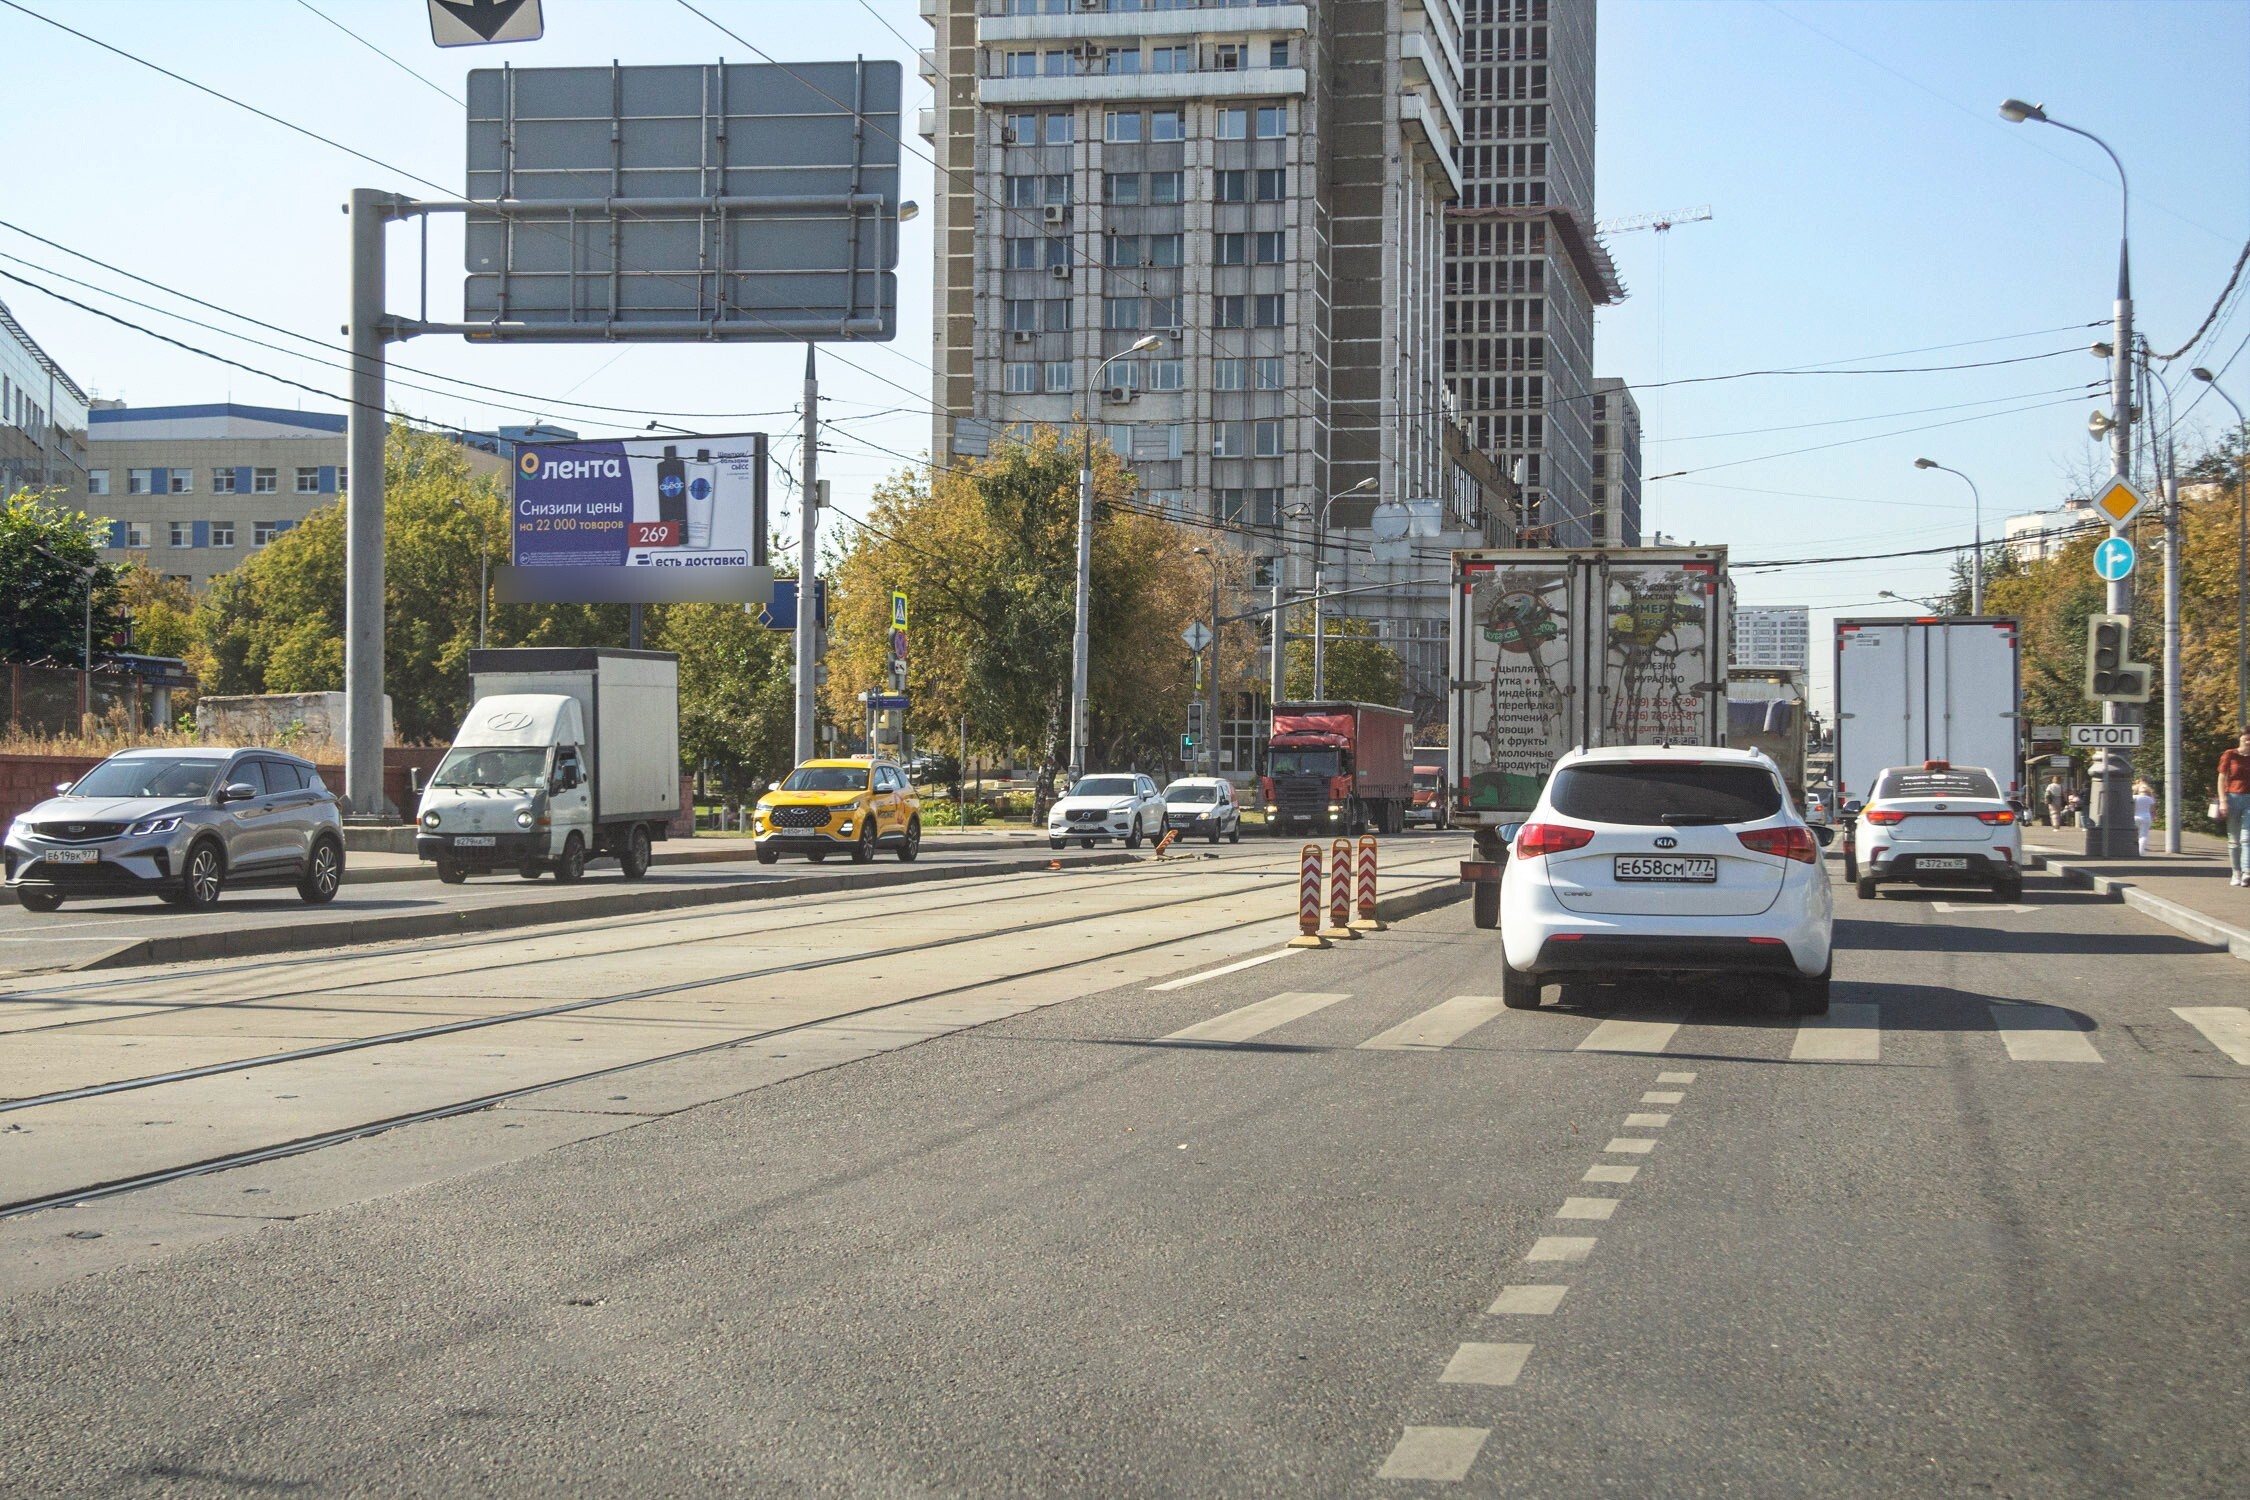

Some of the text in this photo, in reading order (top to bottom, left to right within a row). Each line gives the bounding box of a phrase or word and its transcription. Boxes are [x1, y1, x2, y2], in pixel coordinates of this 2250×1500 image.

[542, 459, 622, 480] лента
[519, 499, 623, 517] Снизили цены
[519, 518, 624, 532] на 22 000 товаров
[639, 526, 669, 543] 269
[656, 556, 745, 566] есть доставка
[1641, 618, 1700, 626] ПРОКТОВ
[1499, 665, 1544, 674] цыплята
[1498, 678, 1556, 687] утка гусь
[1627, 675, 1685, 684] ТУРАЛЬНО
[1498, 688, 1544, 698] индейка
[1498, 702, 1555, 711] перепелка
[1498, 714, 1549, 722] копчения
[1498, 726, 1534, 735] овощи
[2078, 728, 2133, 743] СТОП
[1507, 737, 1548, 748] фрукты
[1498, 750, 1554, 758] молочные
[1497, 761, 1549, 770] продукты
[1656, 838, 1675, 847] KIA
[47, 850, 81, 861] Е619ВК
[1621, 859, 1711, 876] Е658СМ 777
